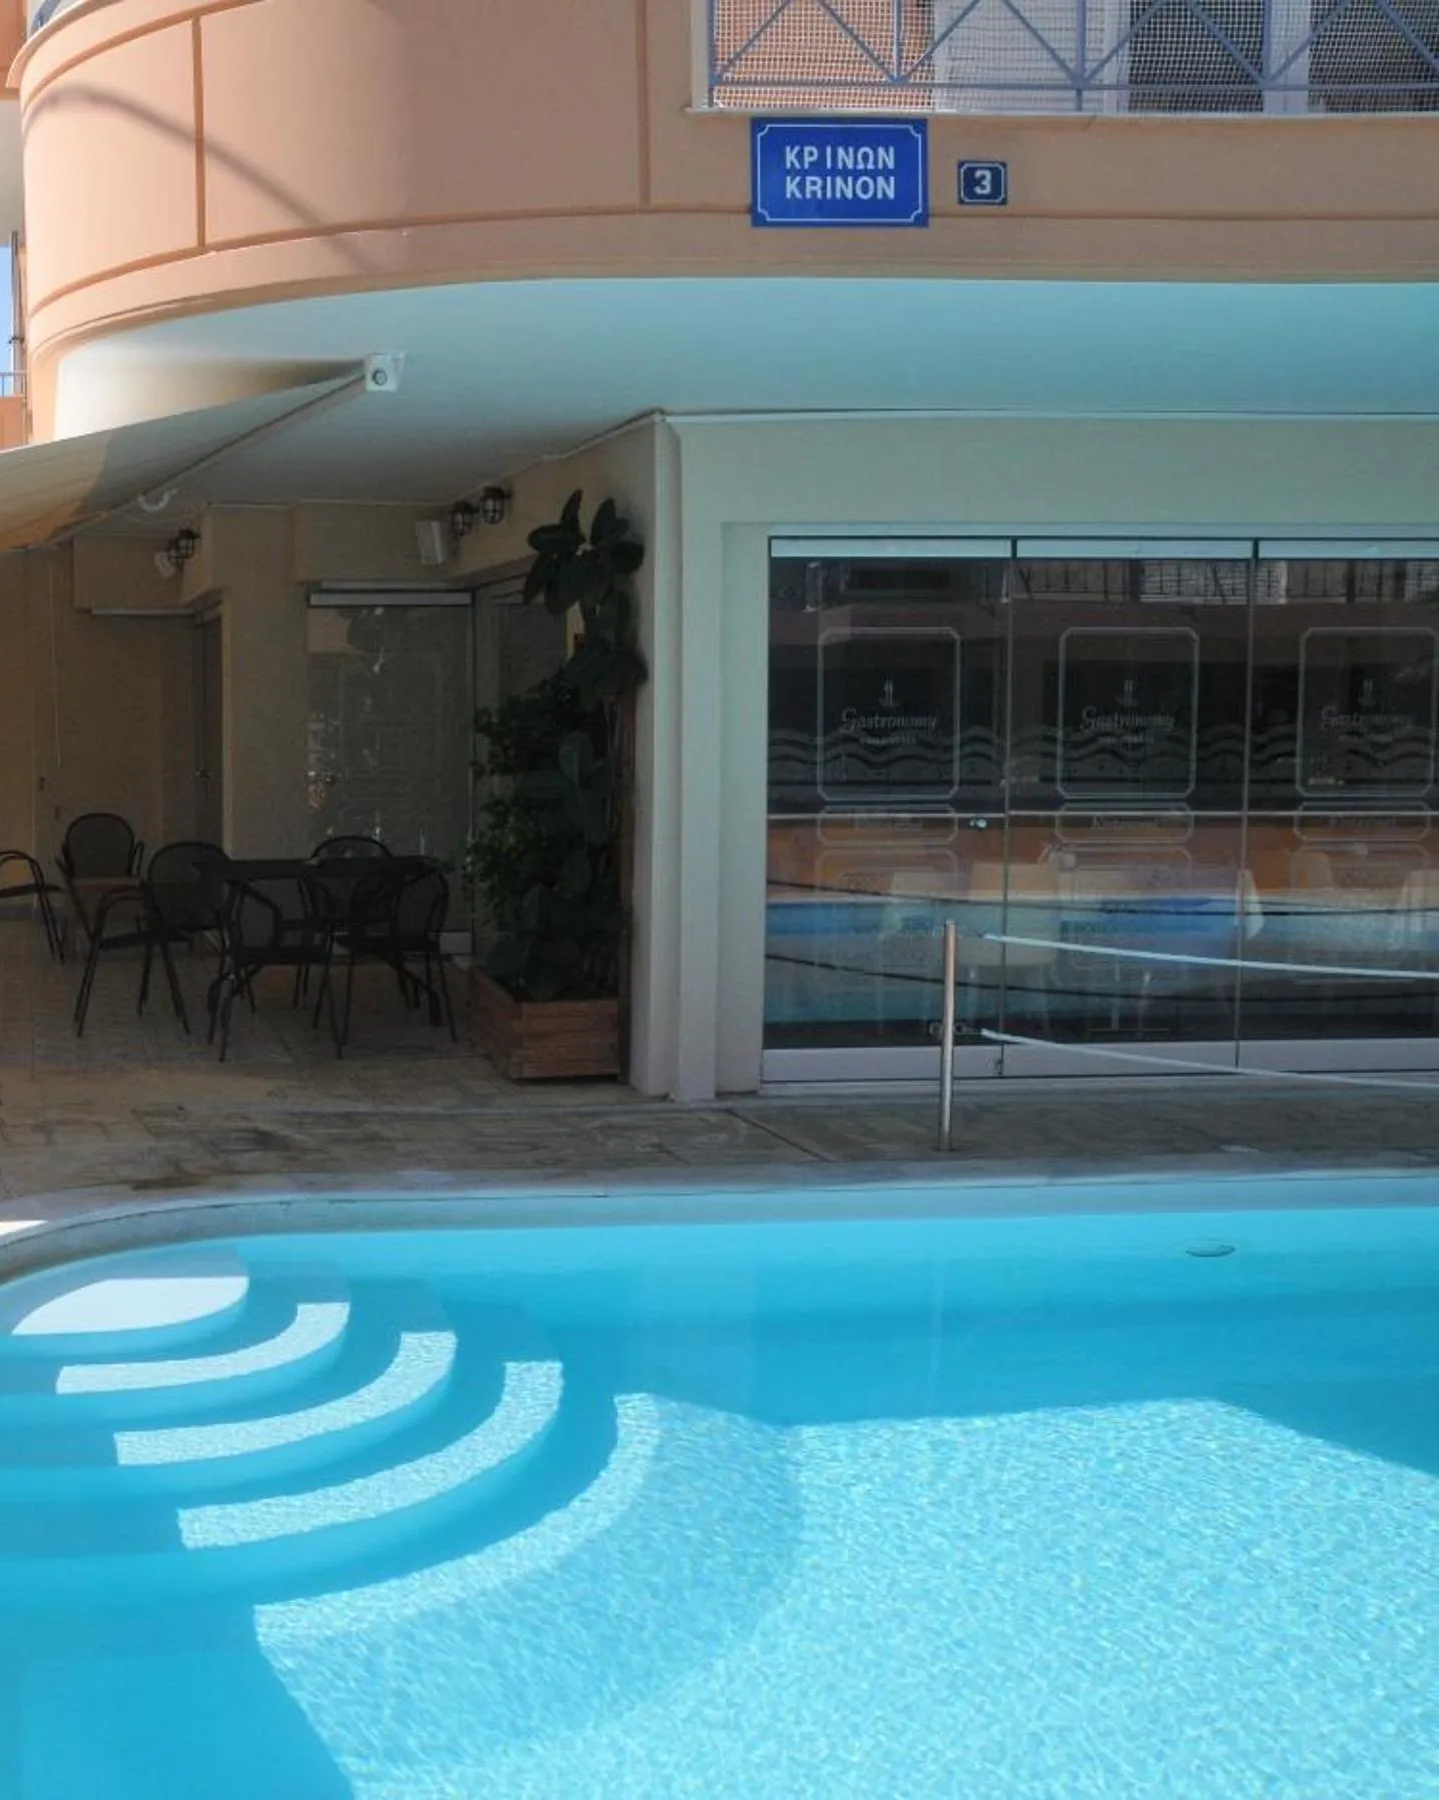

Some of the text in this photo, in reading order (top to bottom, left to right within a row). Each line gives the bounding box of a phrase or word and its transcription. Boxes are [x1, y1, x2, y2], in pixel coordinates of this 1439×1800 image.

[785, 145, 895, 170] ΚΡΙΝΩΝ
[785, 176, 895, 200] KRINON
[973, 169, 992, 195] 3
